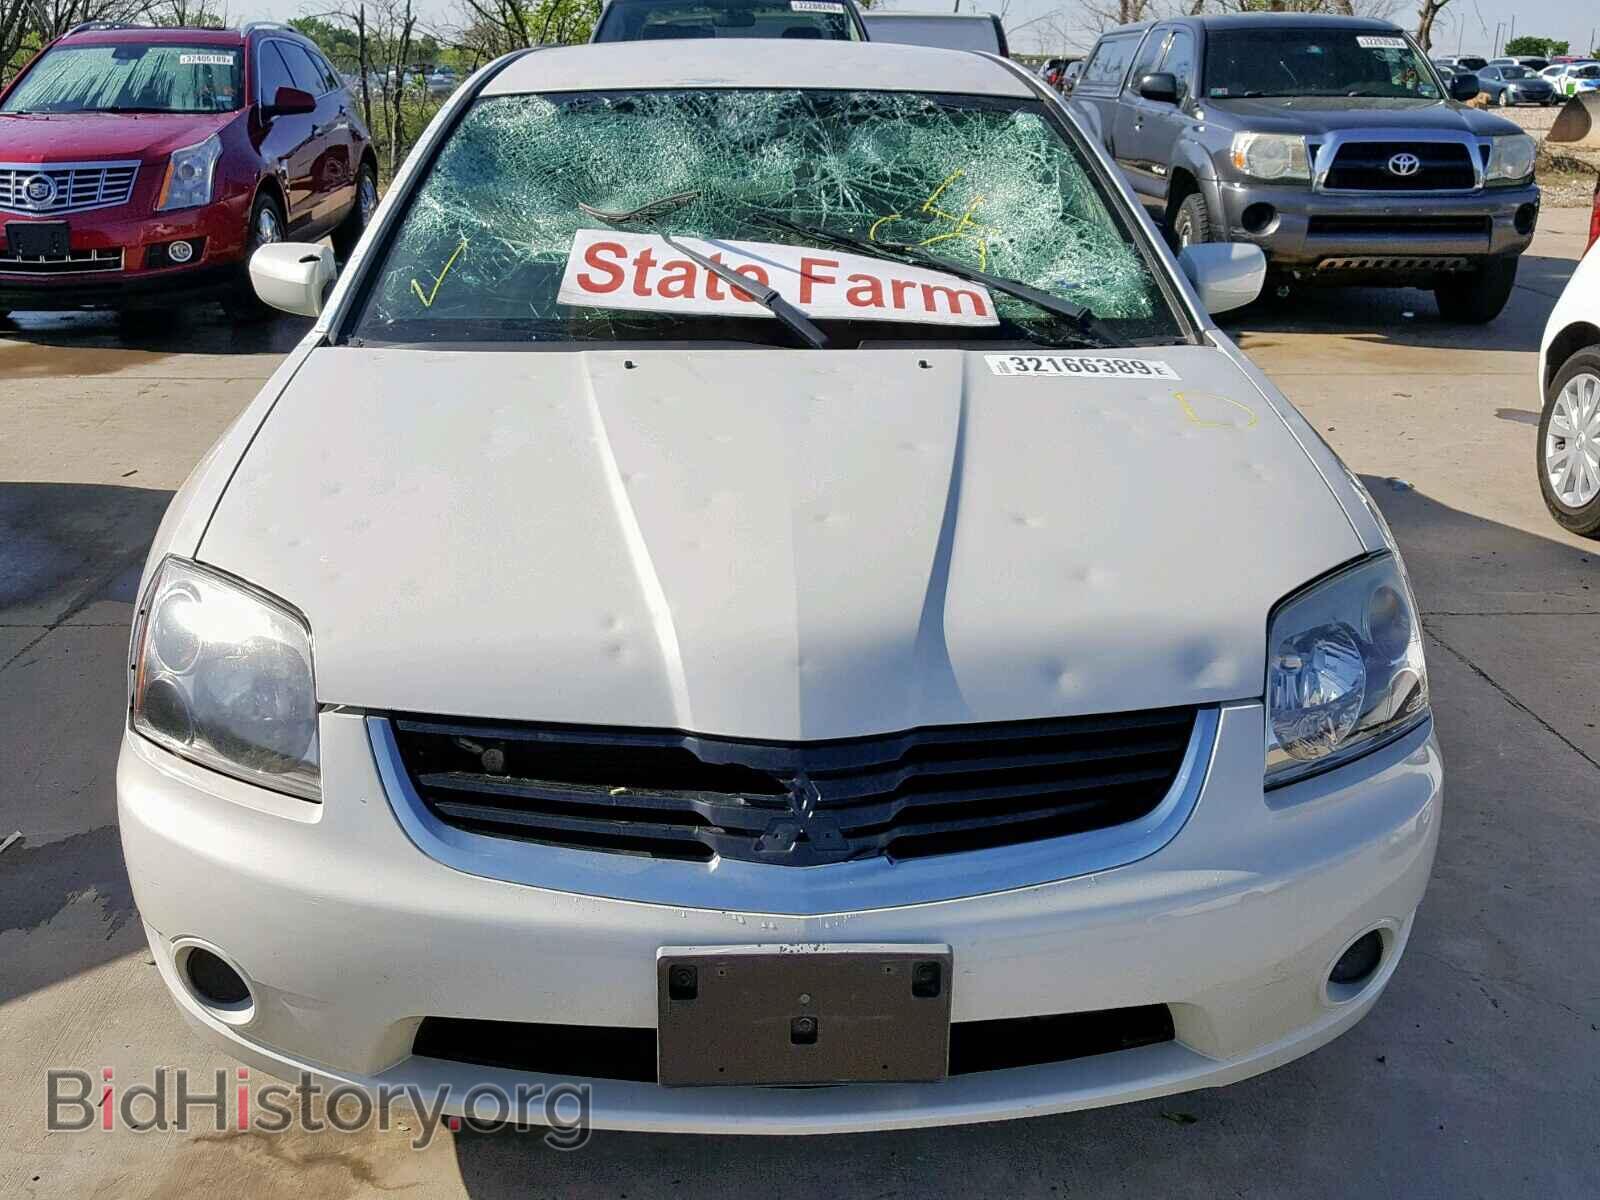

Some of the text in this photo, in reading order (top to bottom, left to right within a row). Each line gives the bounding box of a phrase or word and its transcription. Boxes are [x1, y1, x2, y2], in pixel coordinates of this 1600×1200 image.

[576, 241, 988, 317] State Farm
[1009, 357, 1152, 375] 32166389
